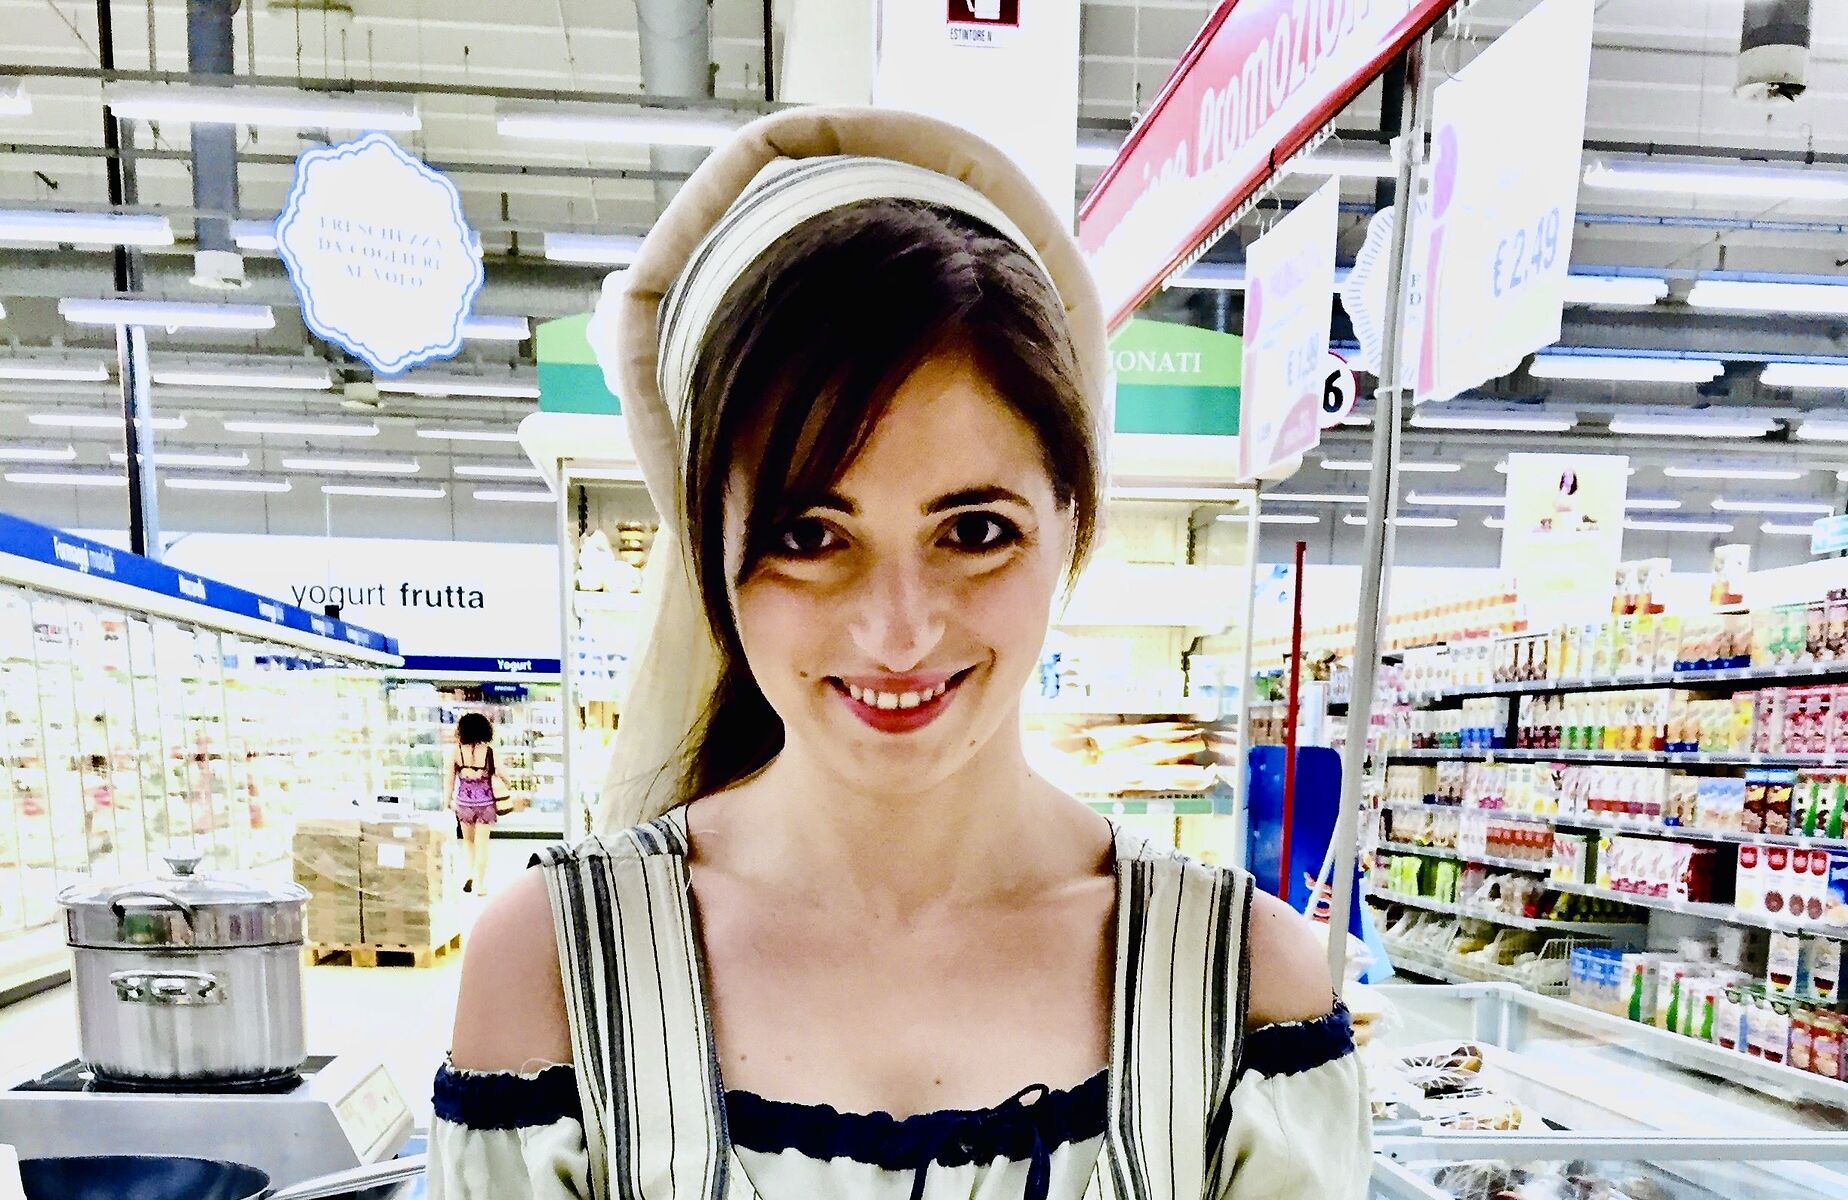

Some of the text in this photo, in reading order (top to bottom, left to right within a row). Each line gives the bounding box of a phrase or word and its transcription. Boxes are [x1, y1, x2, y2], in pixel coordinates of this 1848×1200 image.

[950, 28, 985, 41] ESTINTORE
[1322, 369, 1344, 413] 6
[291, 582, 484, 611] yogurt frutta
[497, 658, 532, 672] Yogurt
